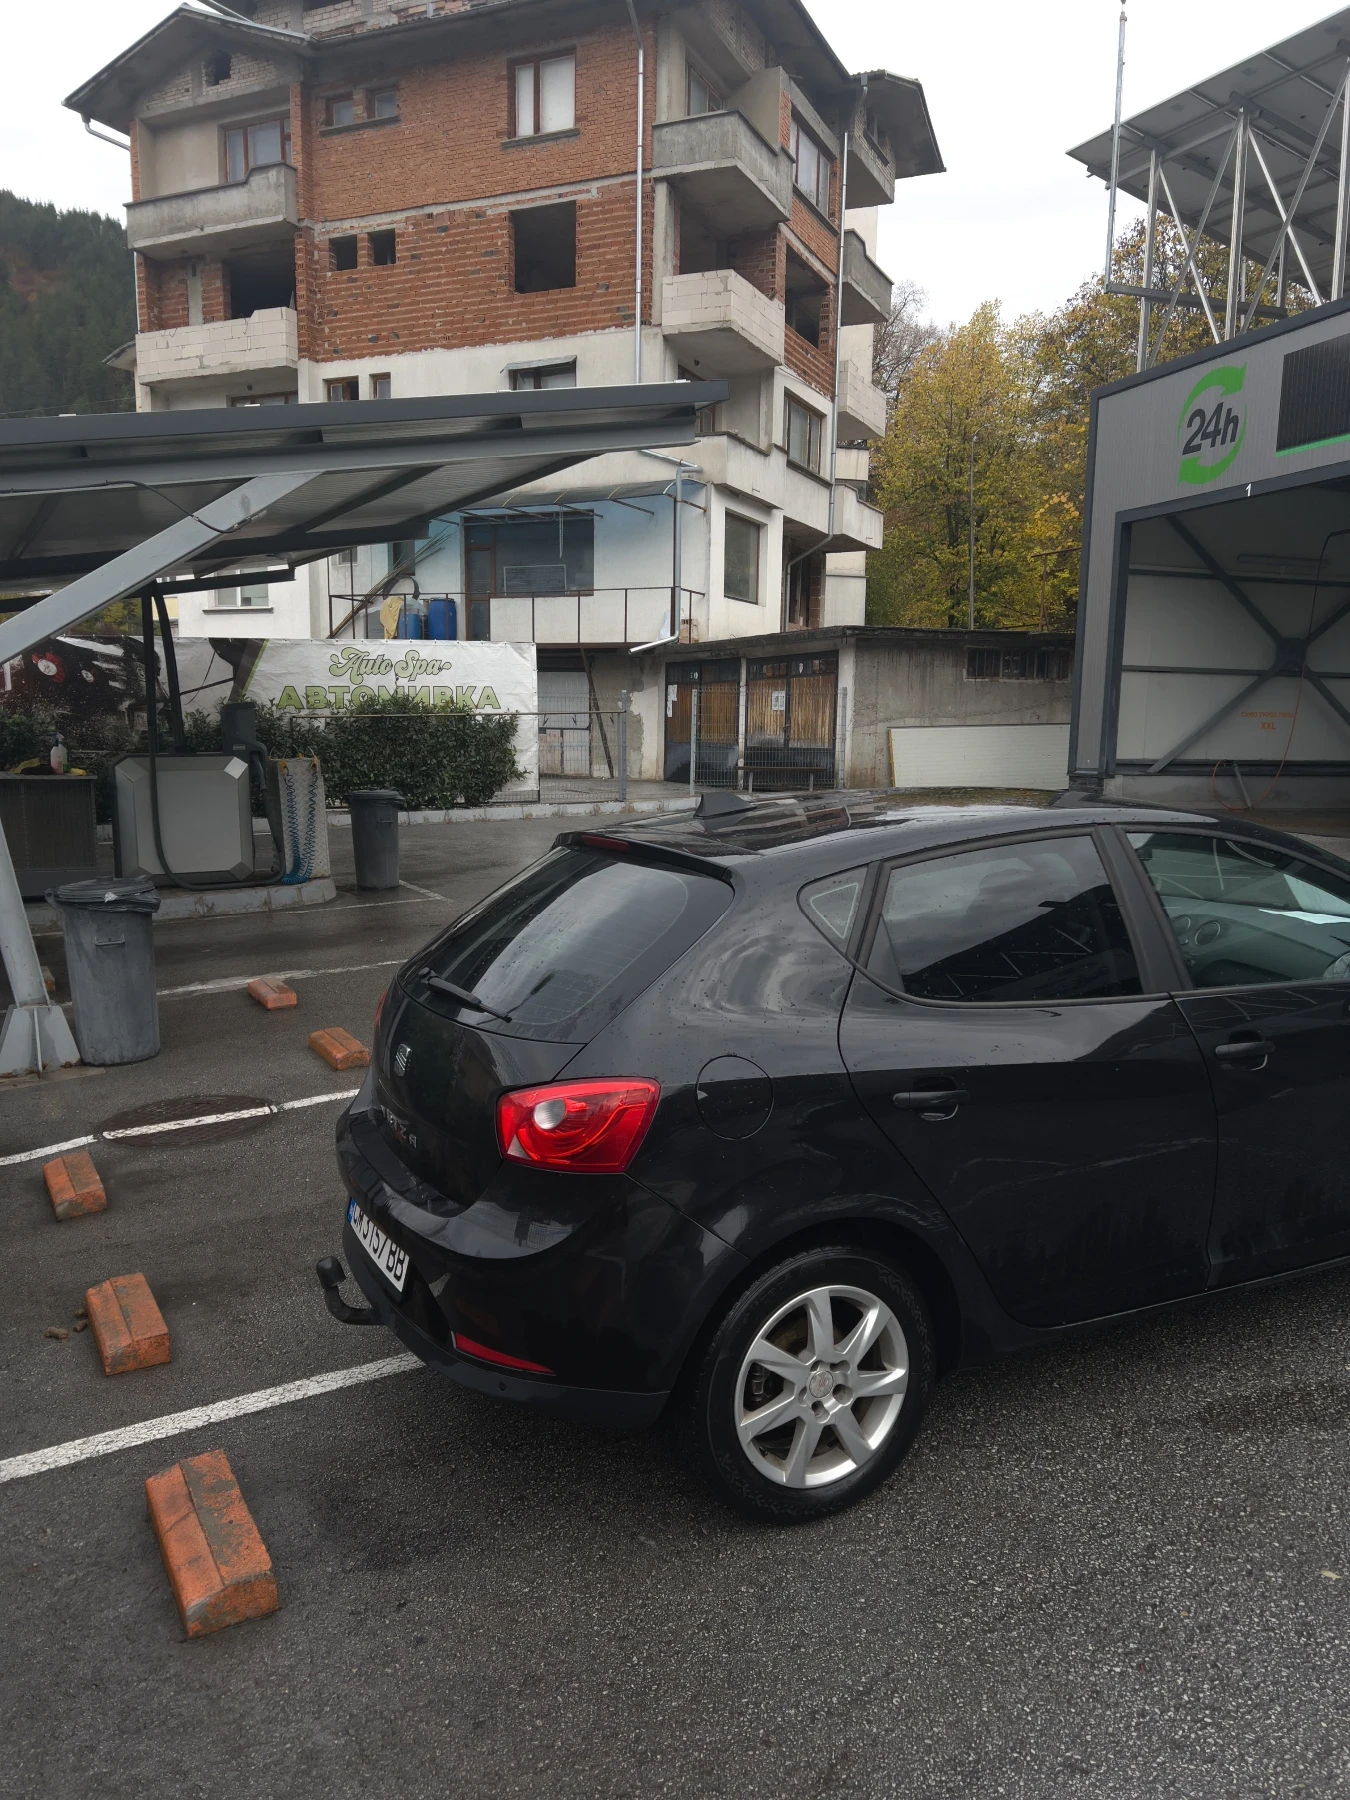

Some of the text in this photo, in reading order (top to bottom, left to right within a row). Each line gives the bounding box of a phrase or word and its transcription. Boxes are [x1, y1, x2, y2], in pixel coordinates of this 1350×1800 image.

[1182, 402, 1239, 456] 24h
[1245, 483, 1252, 497] 1
[328, 647, 452, 685] Auto Spa
[275, 685, 501, 710] АВТОМИВКА
[1261, 722, 1277, 730] XXL
